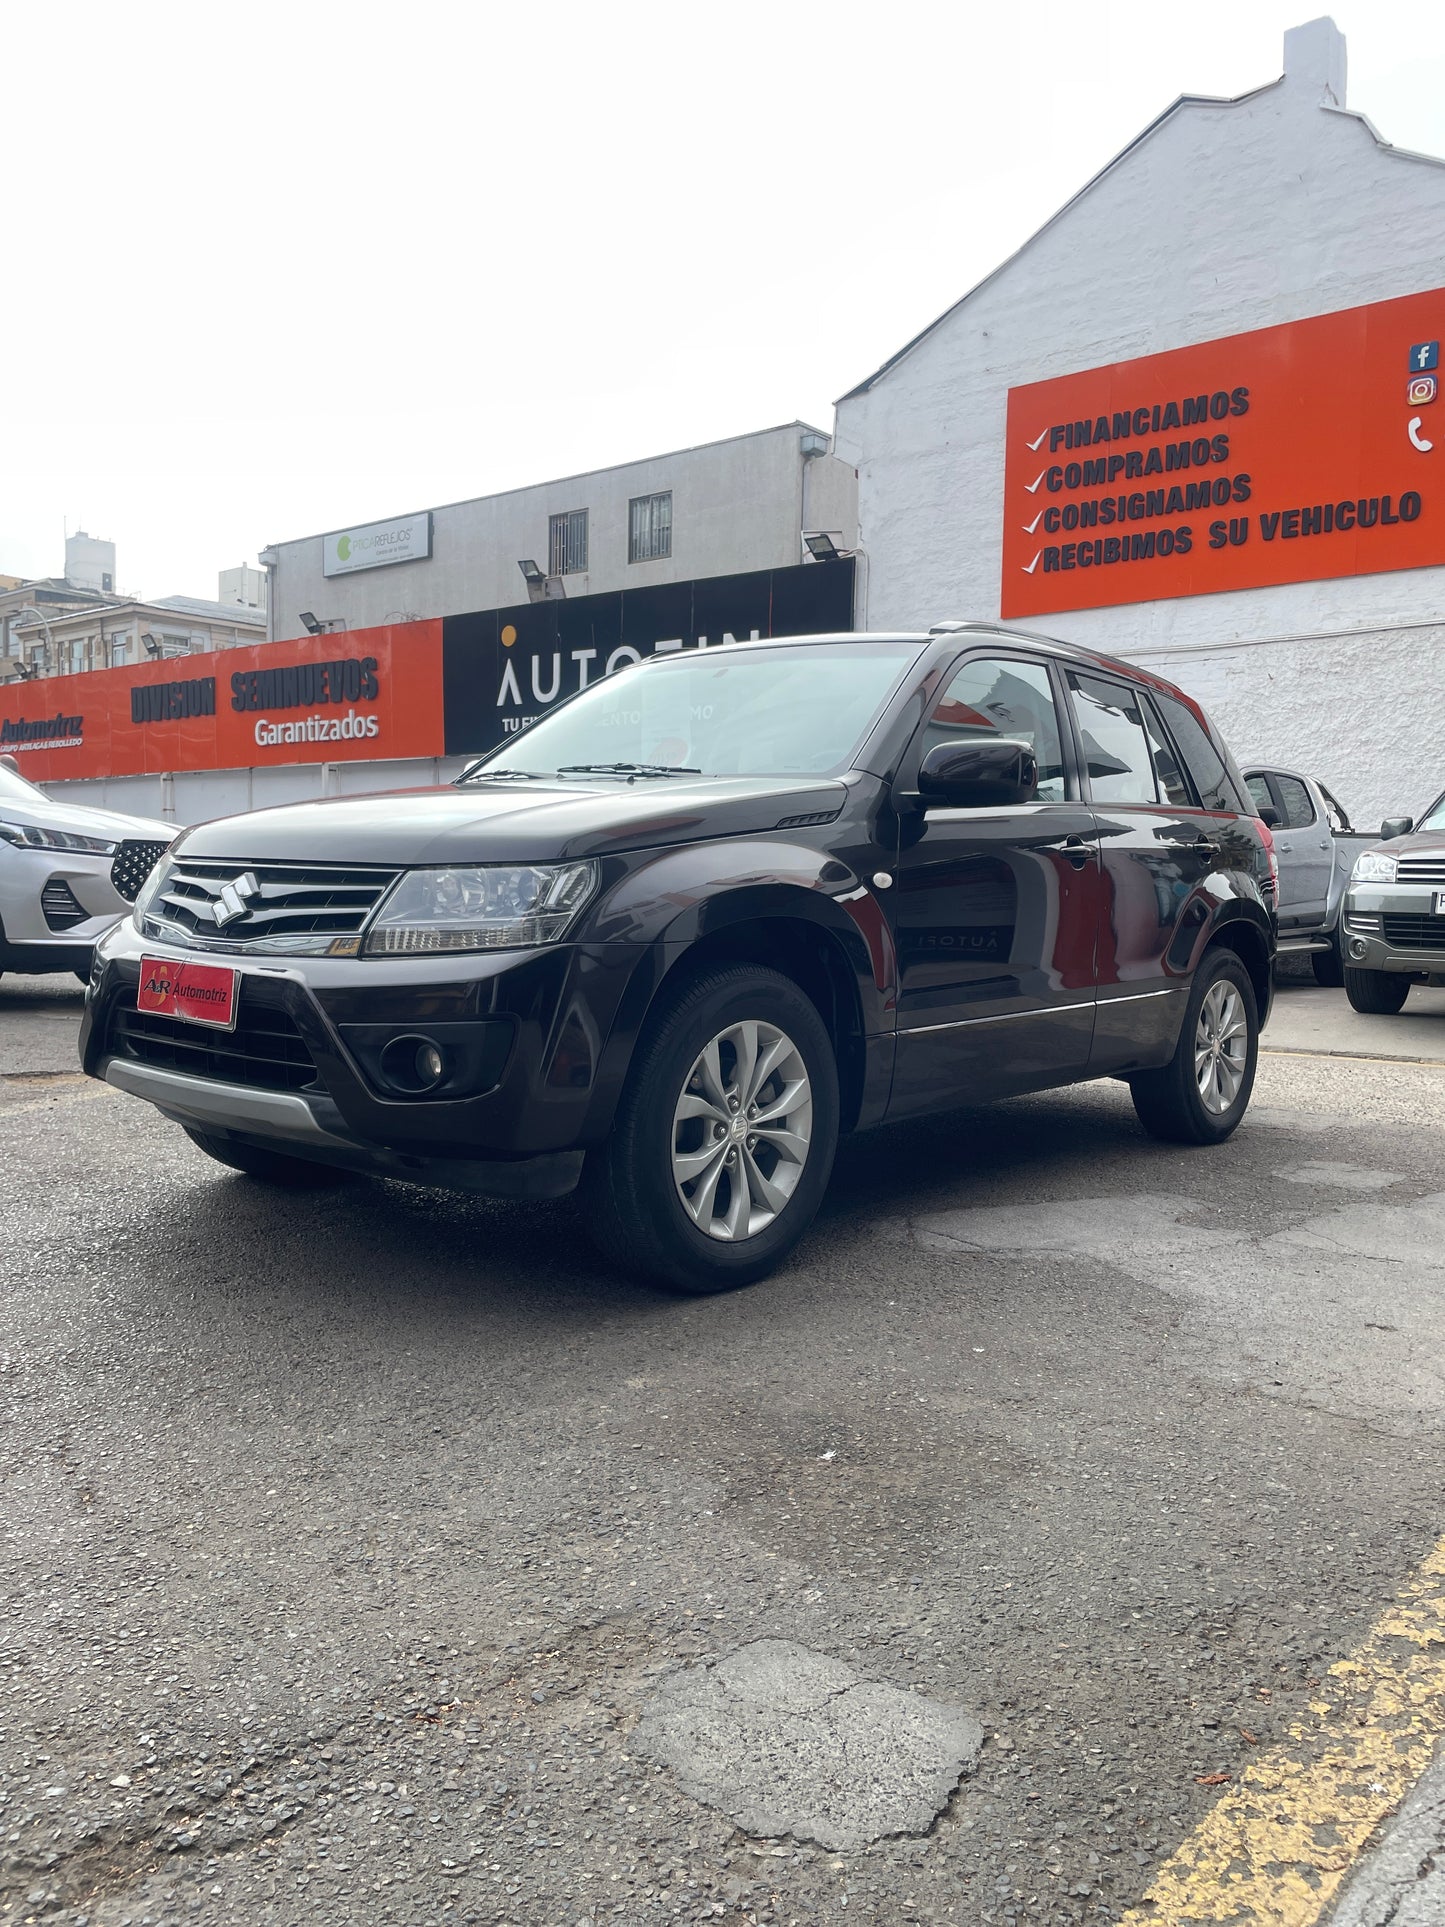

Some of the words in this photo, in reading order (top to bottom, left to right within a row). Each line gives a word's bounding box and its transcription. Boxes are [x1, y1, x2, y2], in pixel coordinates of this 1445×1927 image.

[1049, 386, 1249, 453] FINANCIAMOS
[1046, 434, 1230, 493] COMPRAMOS
[1043, 473, 1252, 533] CONSIGNAMOS
[1043, 526, 1193, 573] RECIBIMOS
[1208, 517, 1249, 549] SU
[1259, 491, 1421, 541] VEHICULO
[131, 677, 216, 723] DIVISION
[230, 657, 379, 712] SEMINUEVOS
[0, 712, 84, 743] Automotriz
[254, 709, 379, 747] Garantizados
[501, 718, 519, 733] TU
[172, 981, 227, 1003] Automotriz
